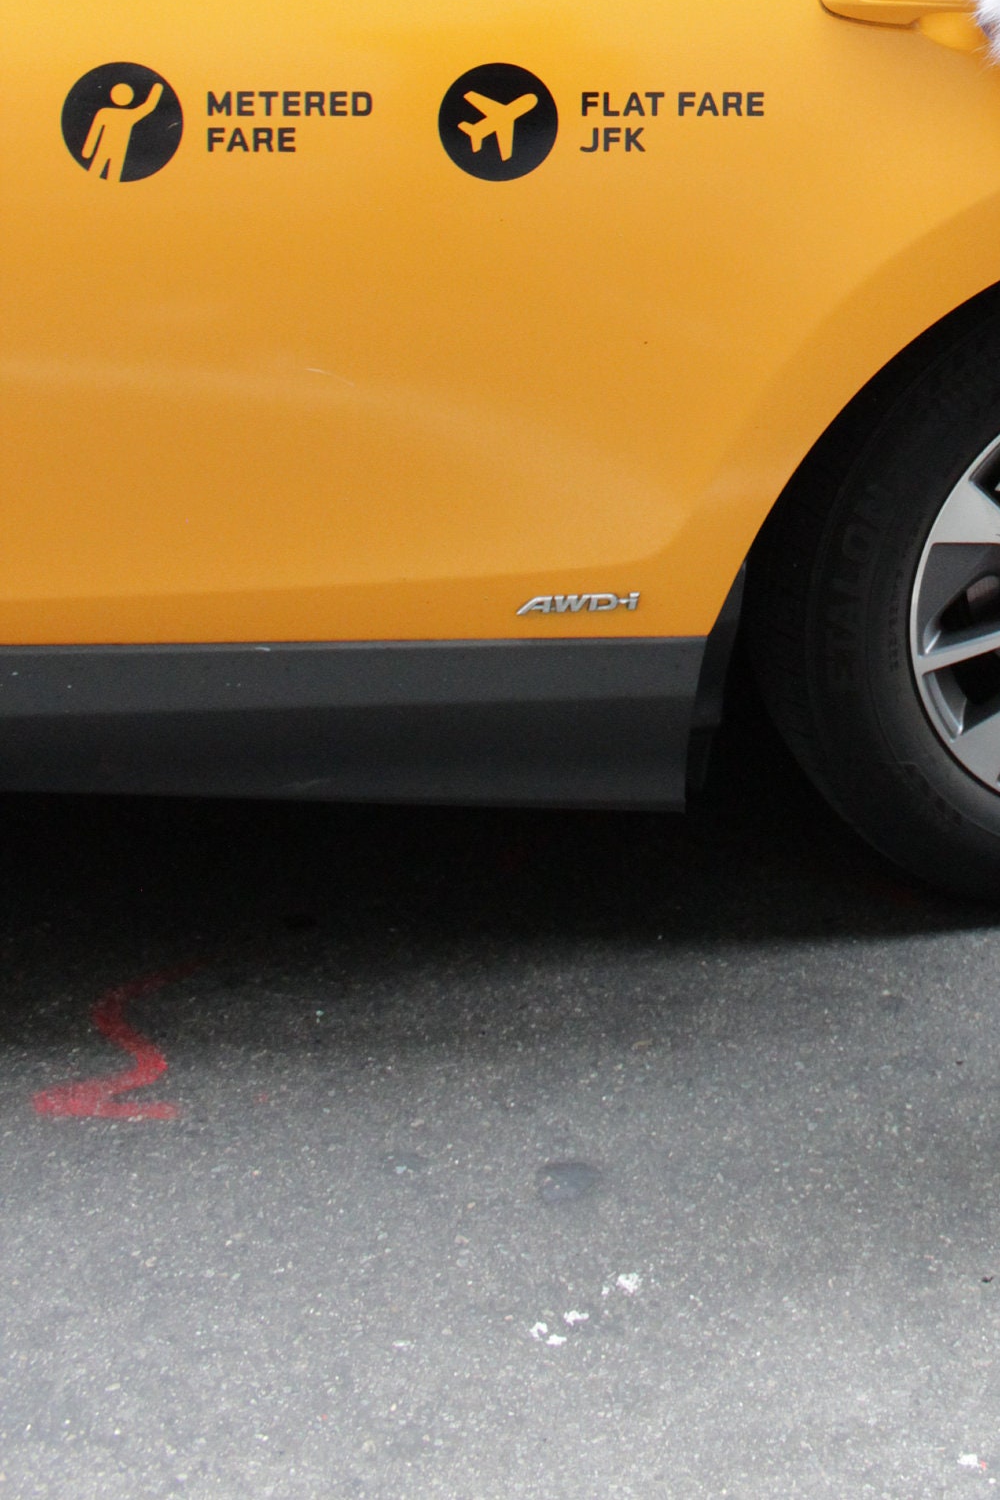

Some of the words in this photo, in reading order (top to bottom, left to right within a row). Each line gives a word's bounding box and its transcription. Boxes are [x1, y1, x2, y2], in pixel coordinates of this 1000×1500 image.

[206, 90, 374, 118] METERED
[580, 90, 663, 118] FLAT
[678, 90, 766, 118] FARE
[206, 126, 298, 153] FARE
[579, 126, 647, 153] JFK
[516, 591, 640, 615] AWD-i
